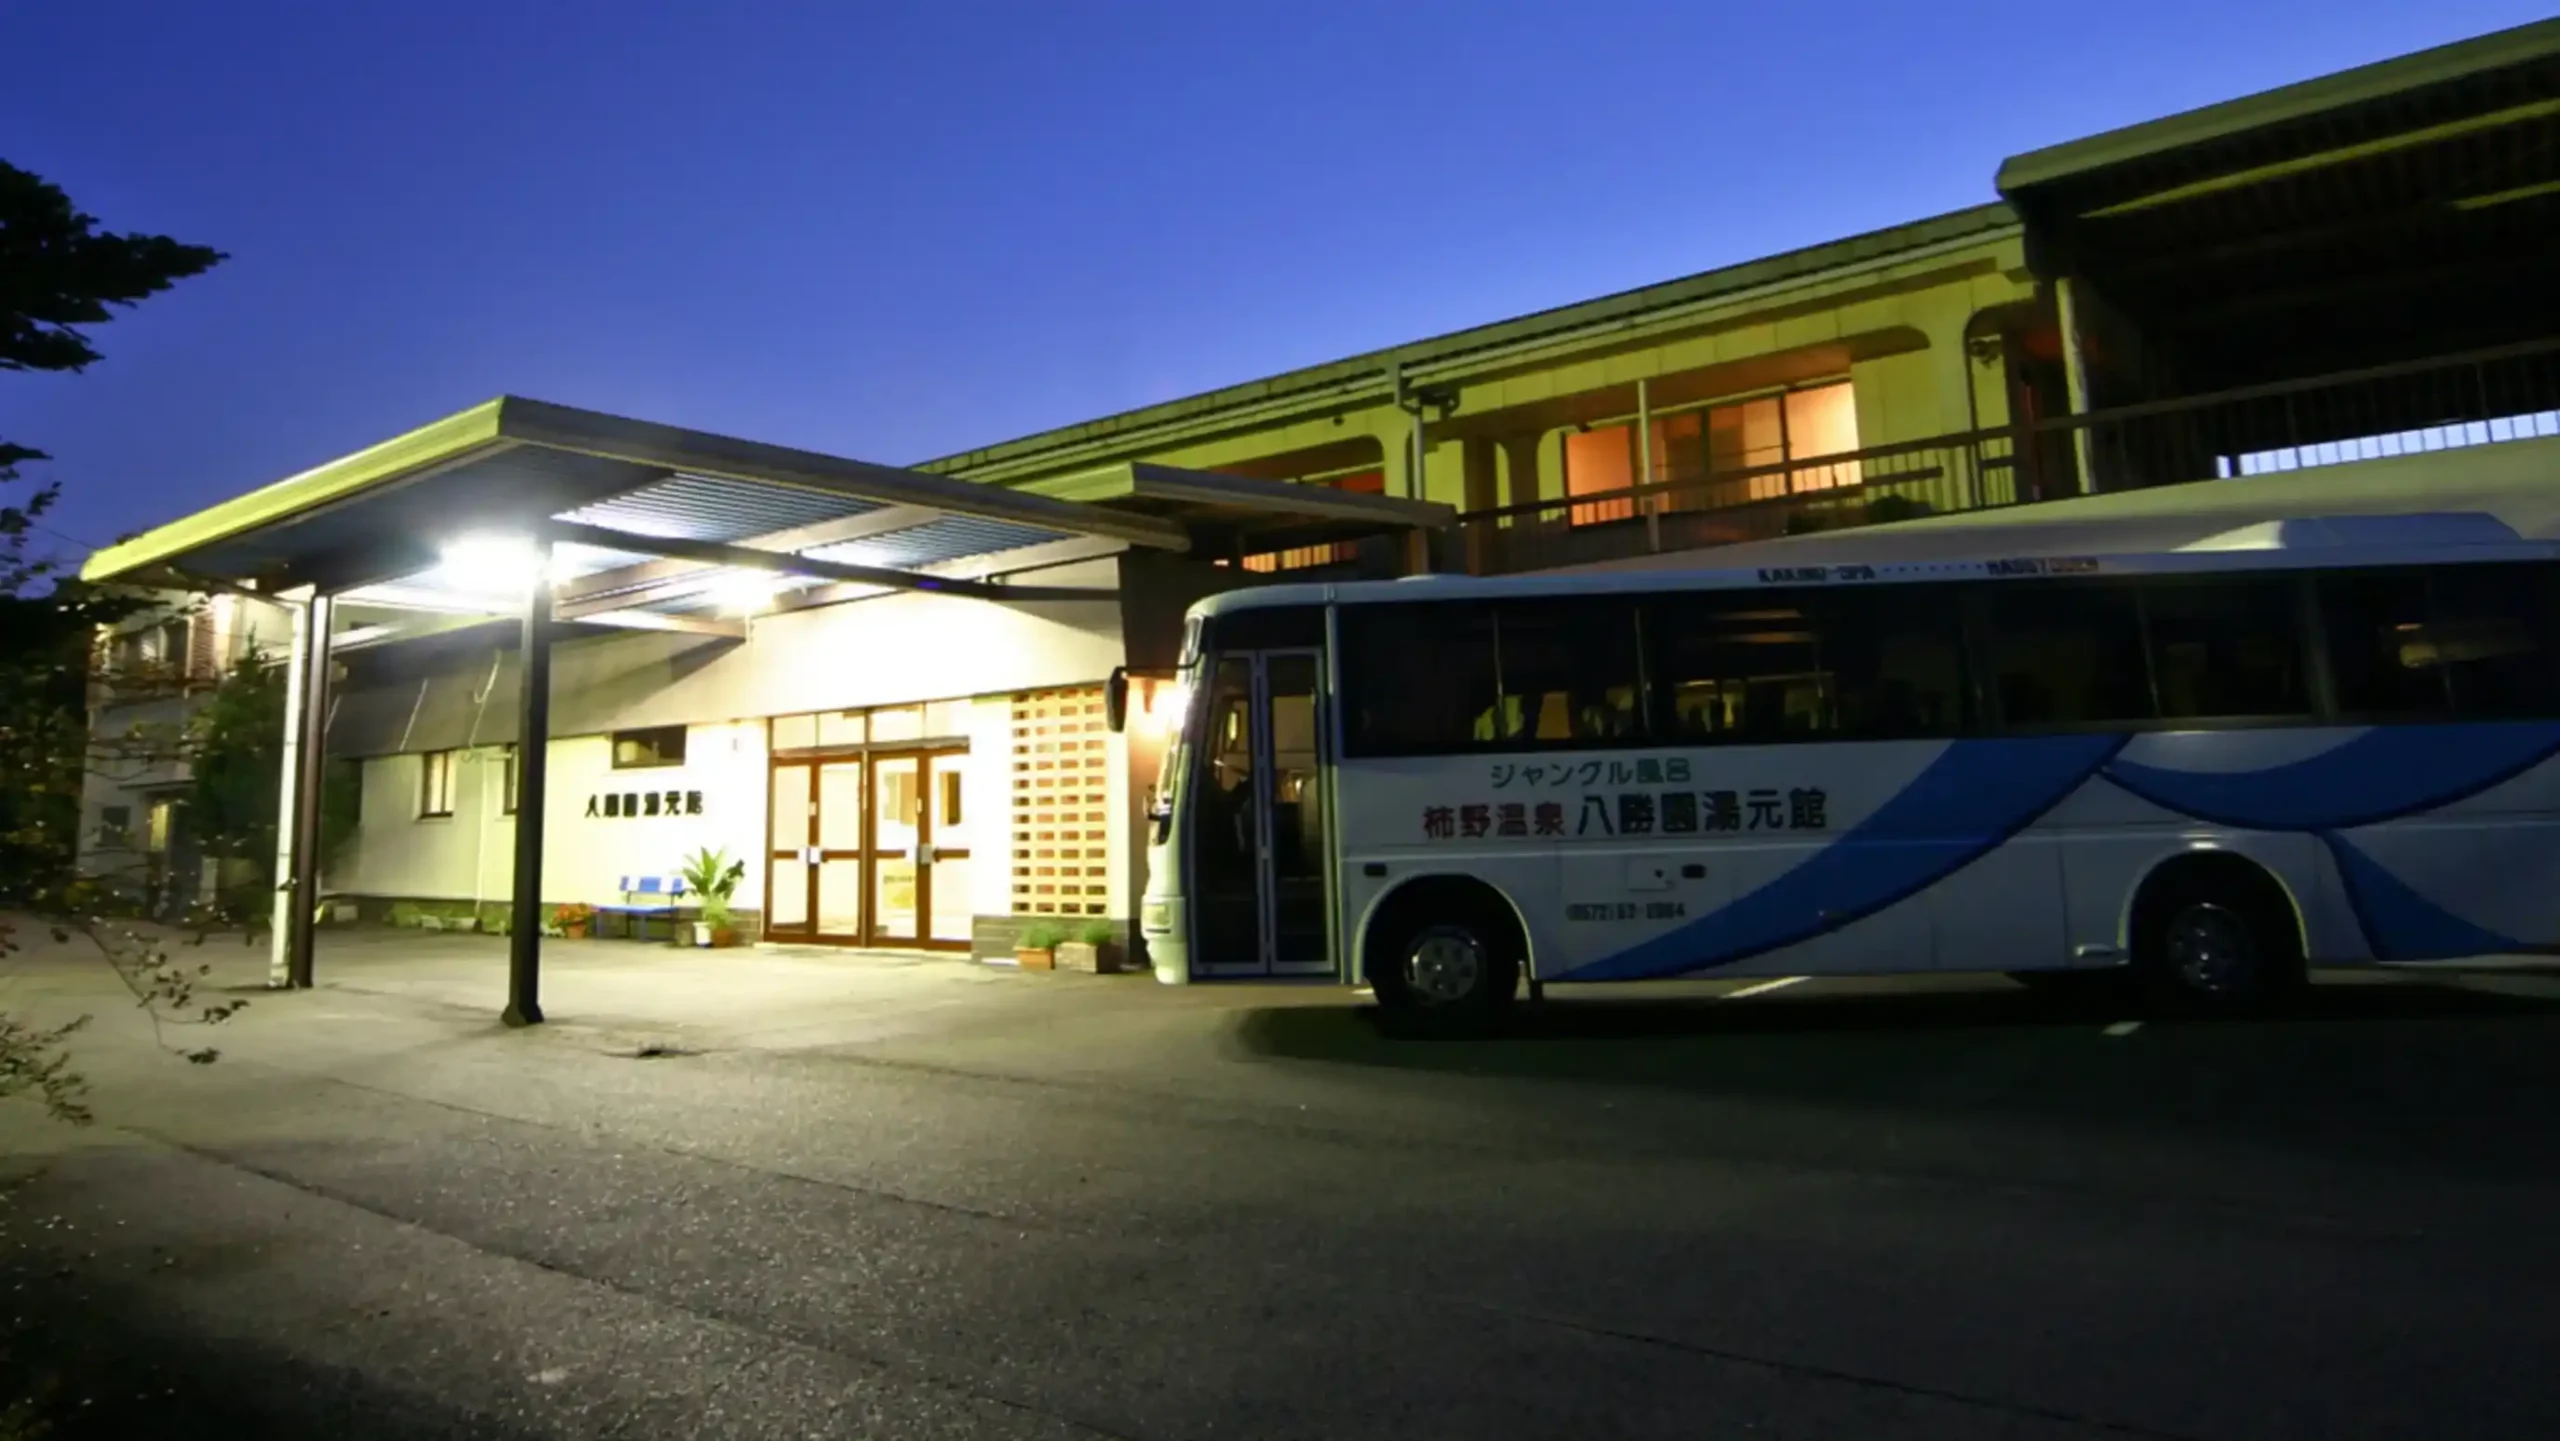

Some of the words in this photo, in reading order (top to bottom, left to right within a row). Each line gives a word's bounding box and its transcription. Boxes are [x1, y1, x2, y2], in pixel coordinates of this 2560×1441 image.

[1491, 759, 1692, 788] ジャングル風呂
[1423, 803, 1565, 839] 柿野温泉
